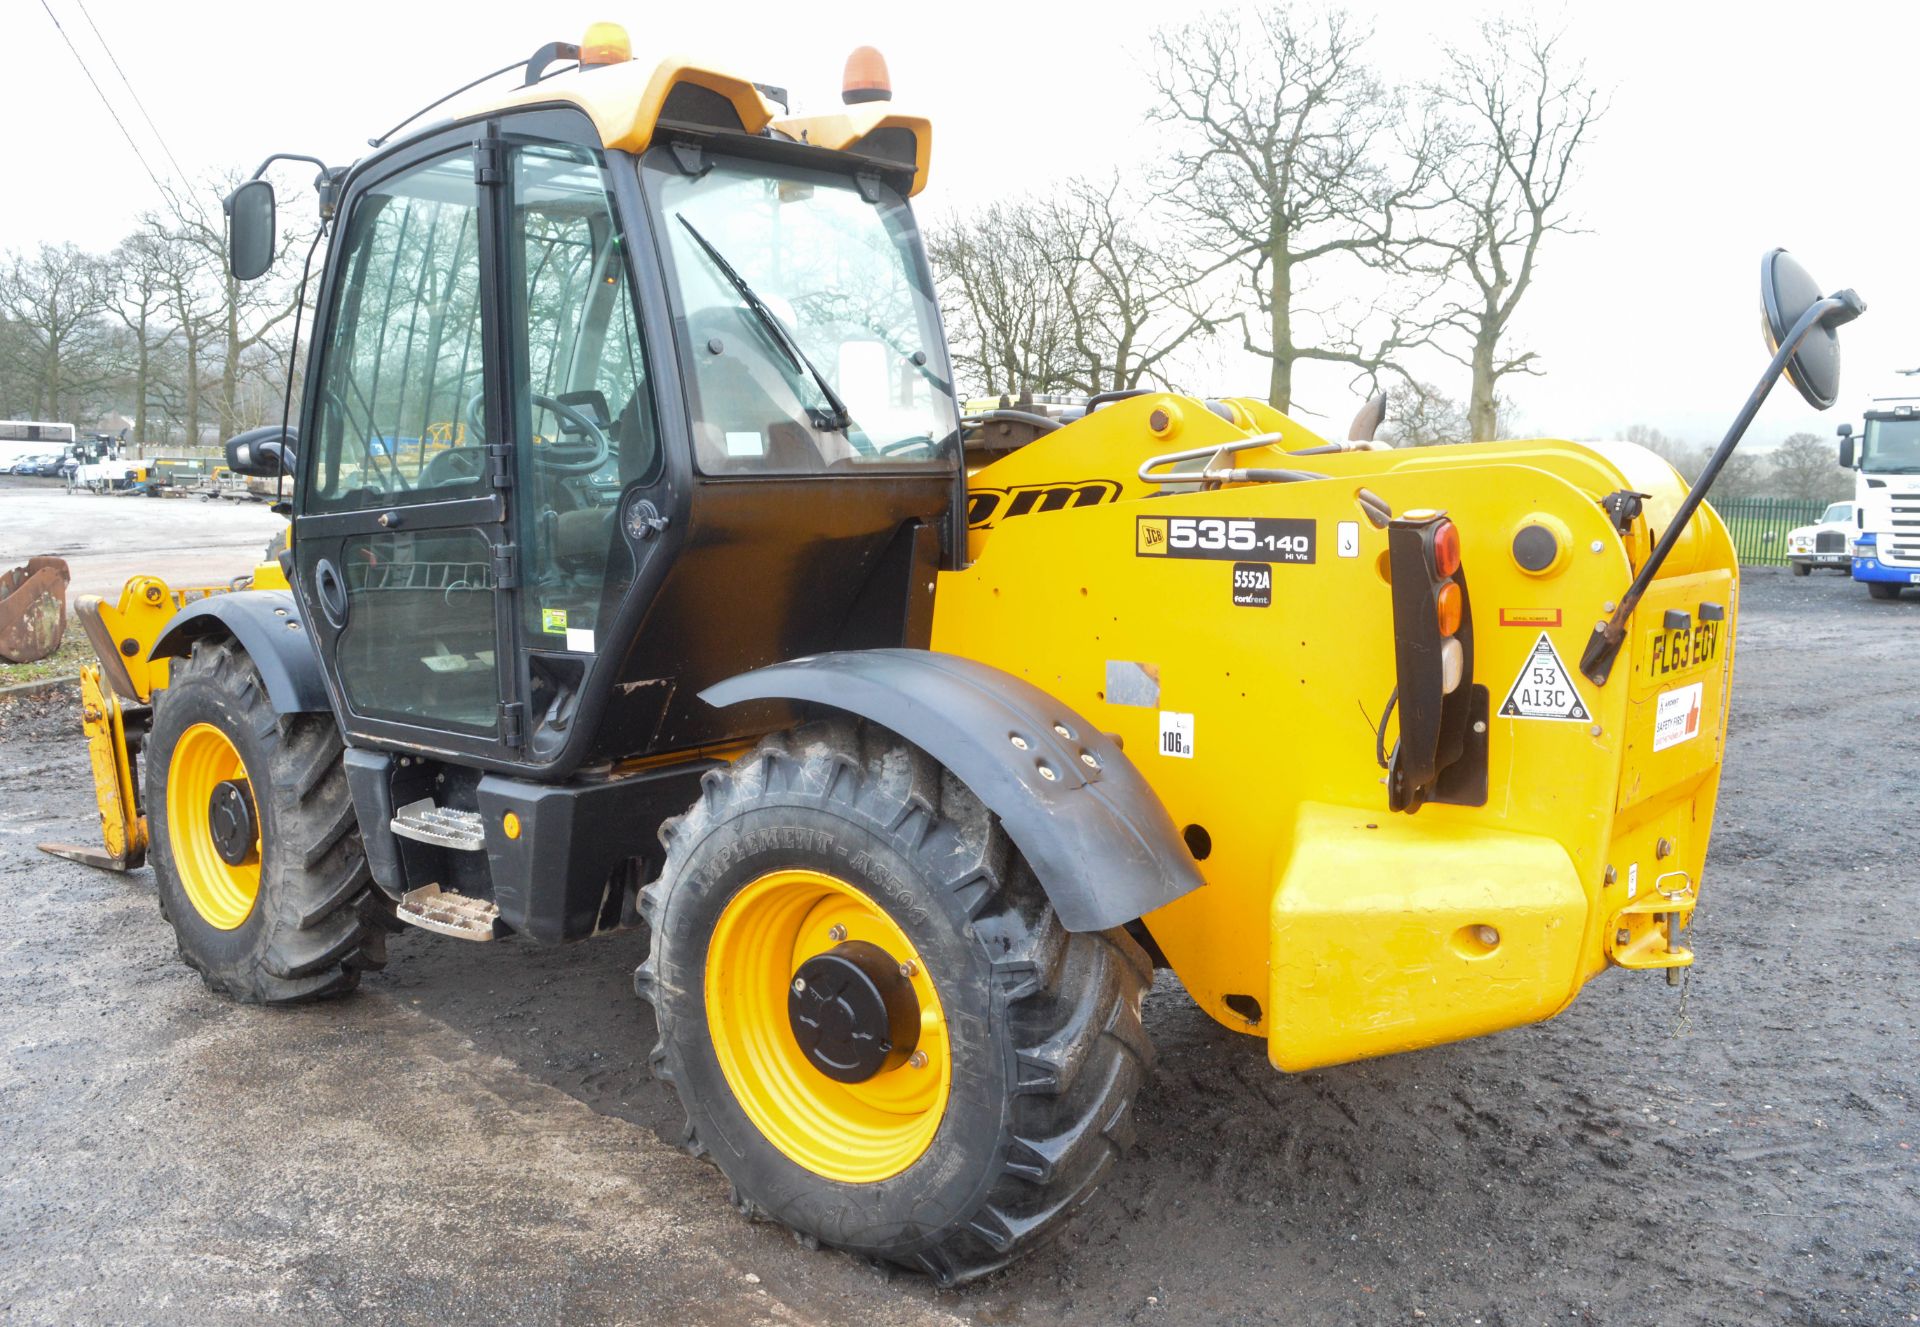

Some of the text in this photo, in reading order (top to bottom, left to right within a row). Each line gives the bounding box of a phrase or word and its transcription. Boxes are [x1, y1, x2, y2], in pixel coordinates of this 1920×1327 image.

[1145, 527, 1163, 545] JCB
[1234, 570, 1270, 589] 5552A
[1651, 628, 1691, 677] FL63
[1533, 667, 1556, 685] 53
[1656, 713, 1685, 733] SAFETY FIRST
[1162, 731, 1182, 753] 106
